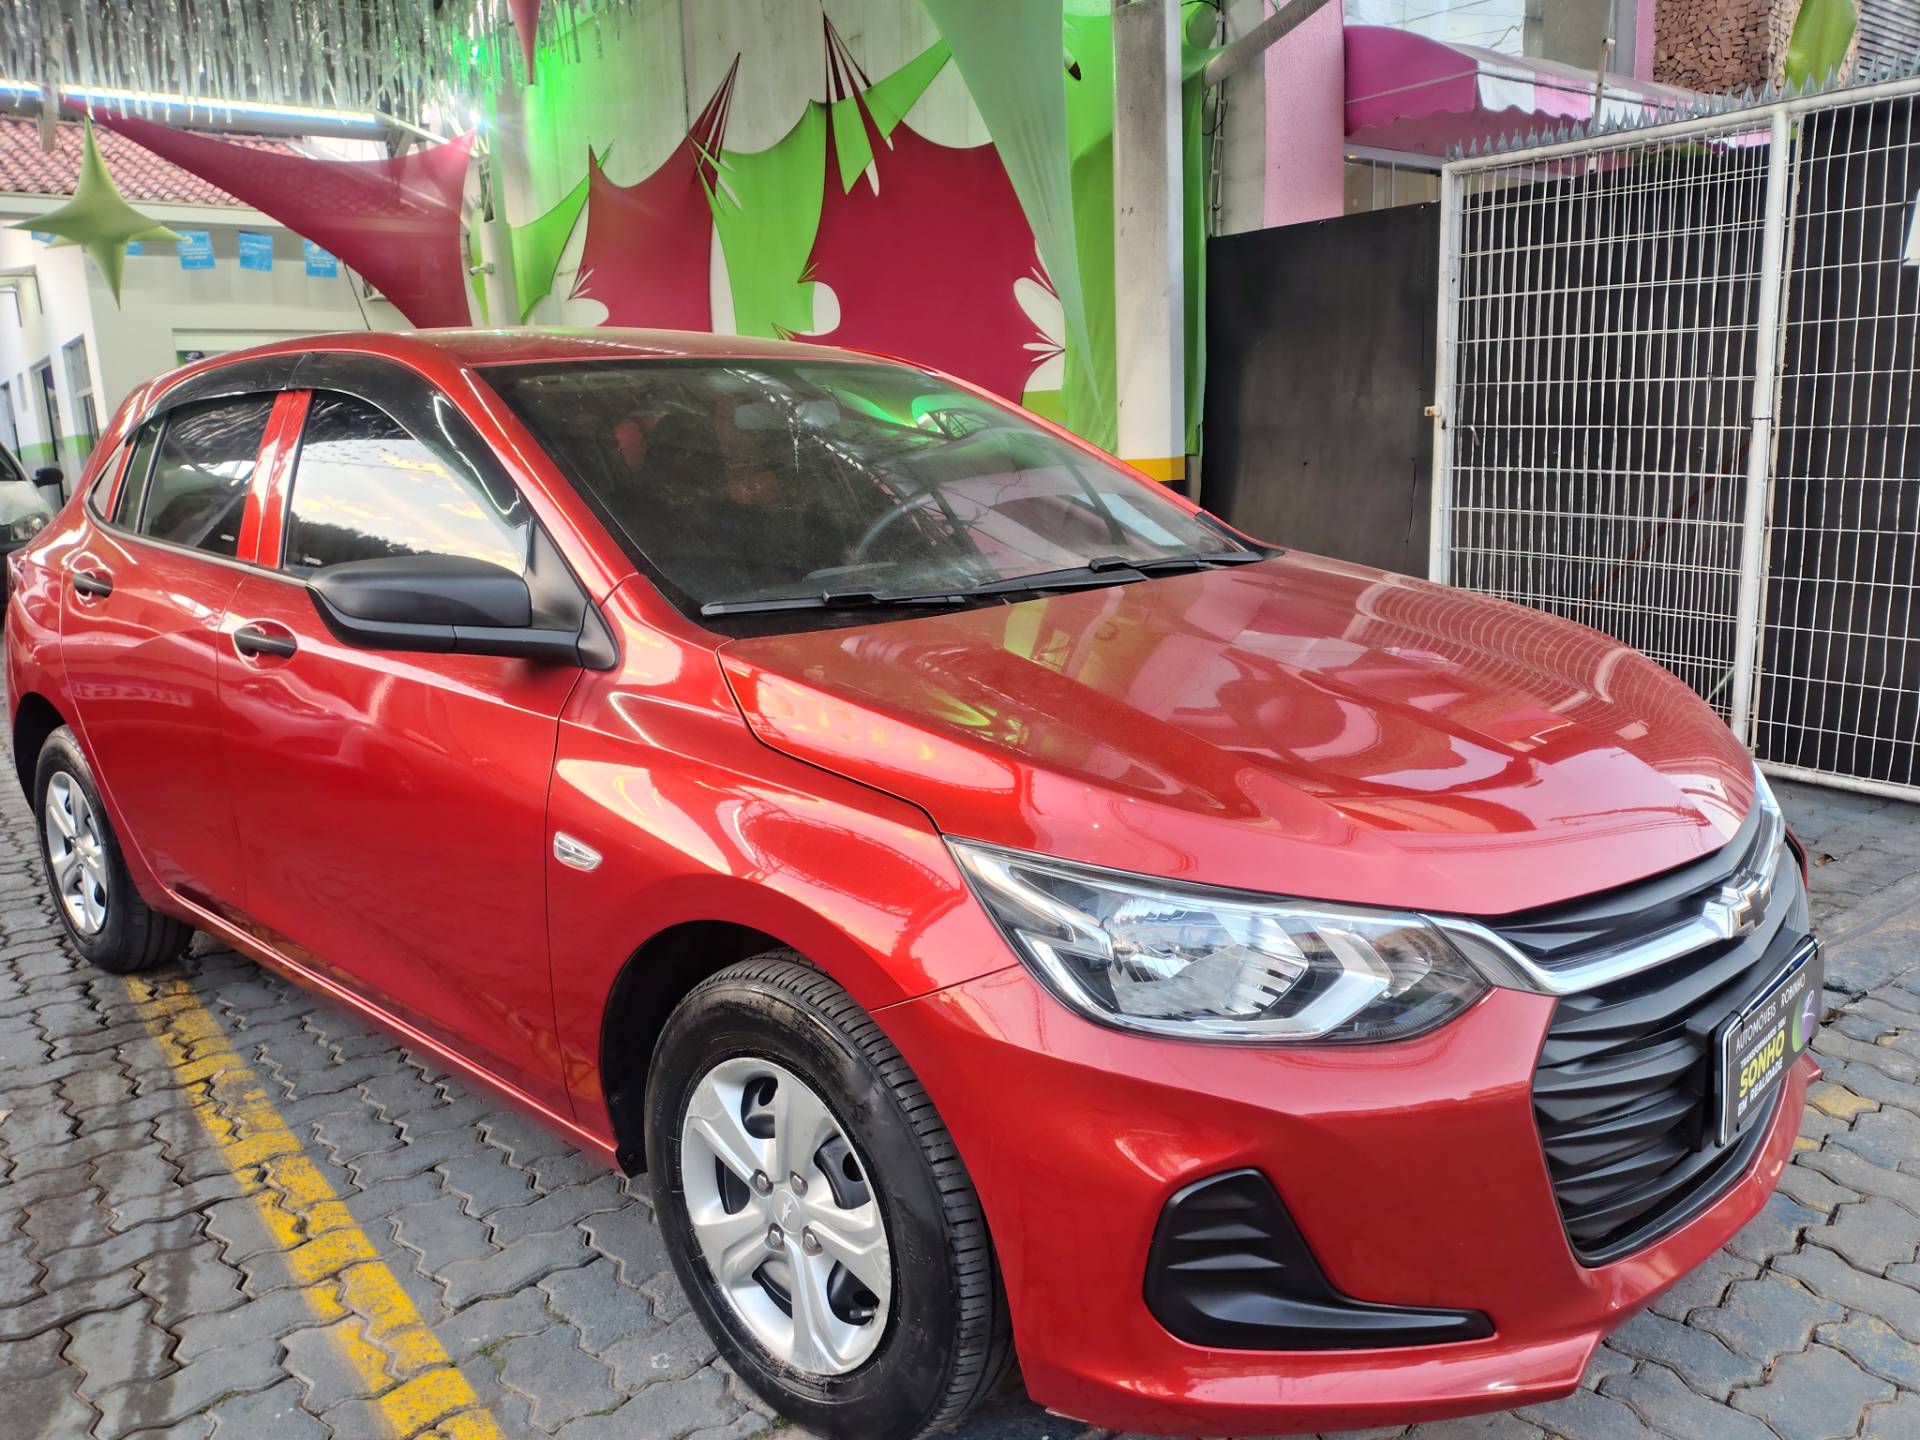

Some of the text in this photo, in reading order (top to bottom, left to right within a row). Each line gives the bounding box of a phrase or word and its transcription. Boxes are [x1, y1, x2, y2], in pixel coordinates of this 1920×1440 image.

[1781, 973, 1805, 1009] ROBINHO
[1738, 1057, 1783, 1117] EM REALIDADE
[1739, 1030, 1785, 1098] SONHO
